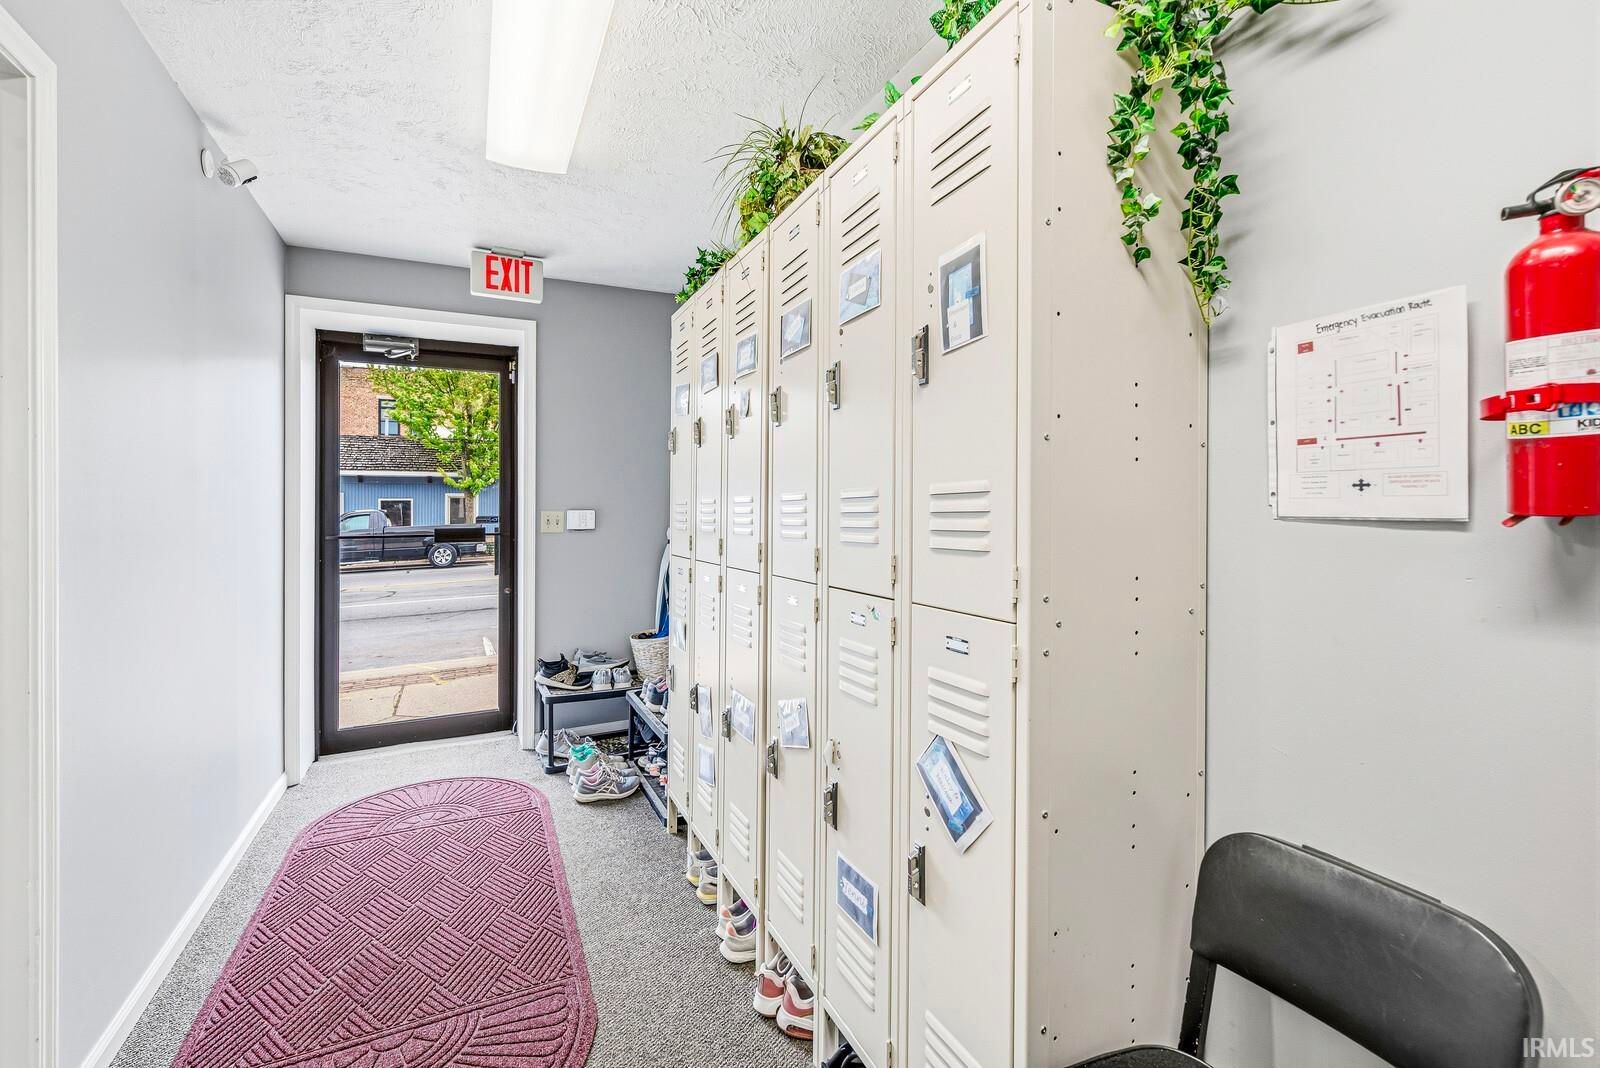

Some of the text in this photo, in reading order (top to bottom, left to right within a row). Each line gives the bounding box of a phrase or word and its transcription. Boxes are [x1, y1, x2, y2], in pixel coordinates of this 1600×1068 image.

[486, 255, 534, 294] EXIT
[1316, 299, 1432, 334] Emergency Evacuation Route
[1511, 423, 1542, 435] ABC
